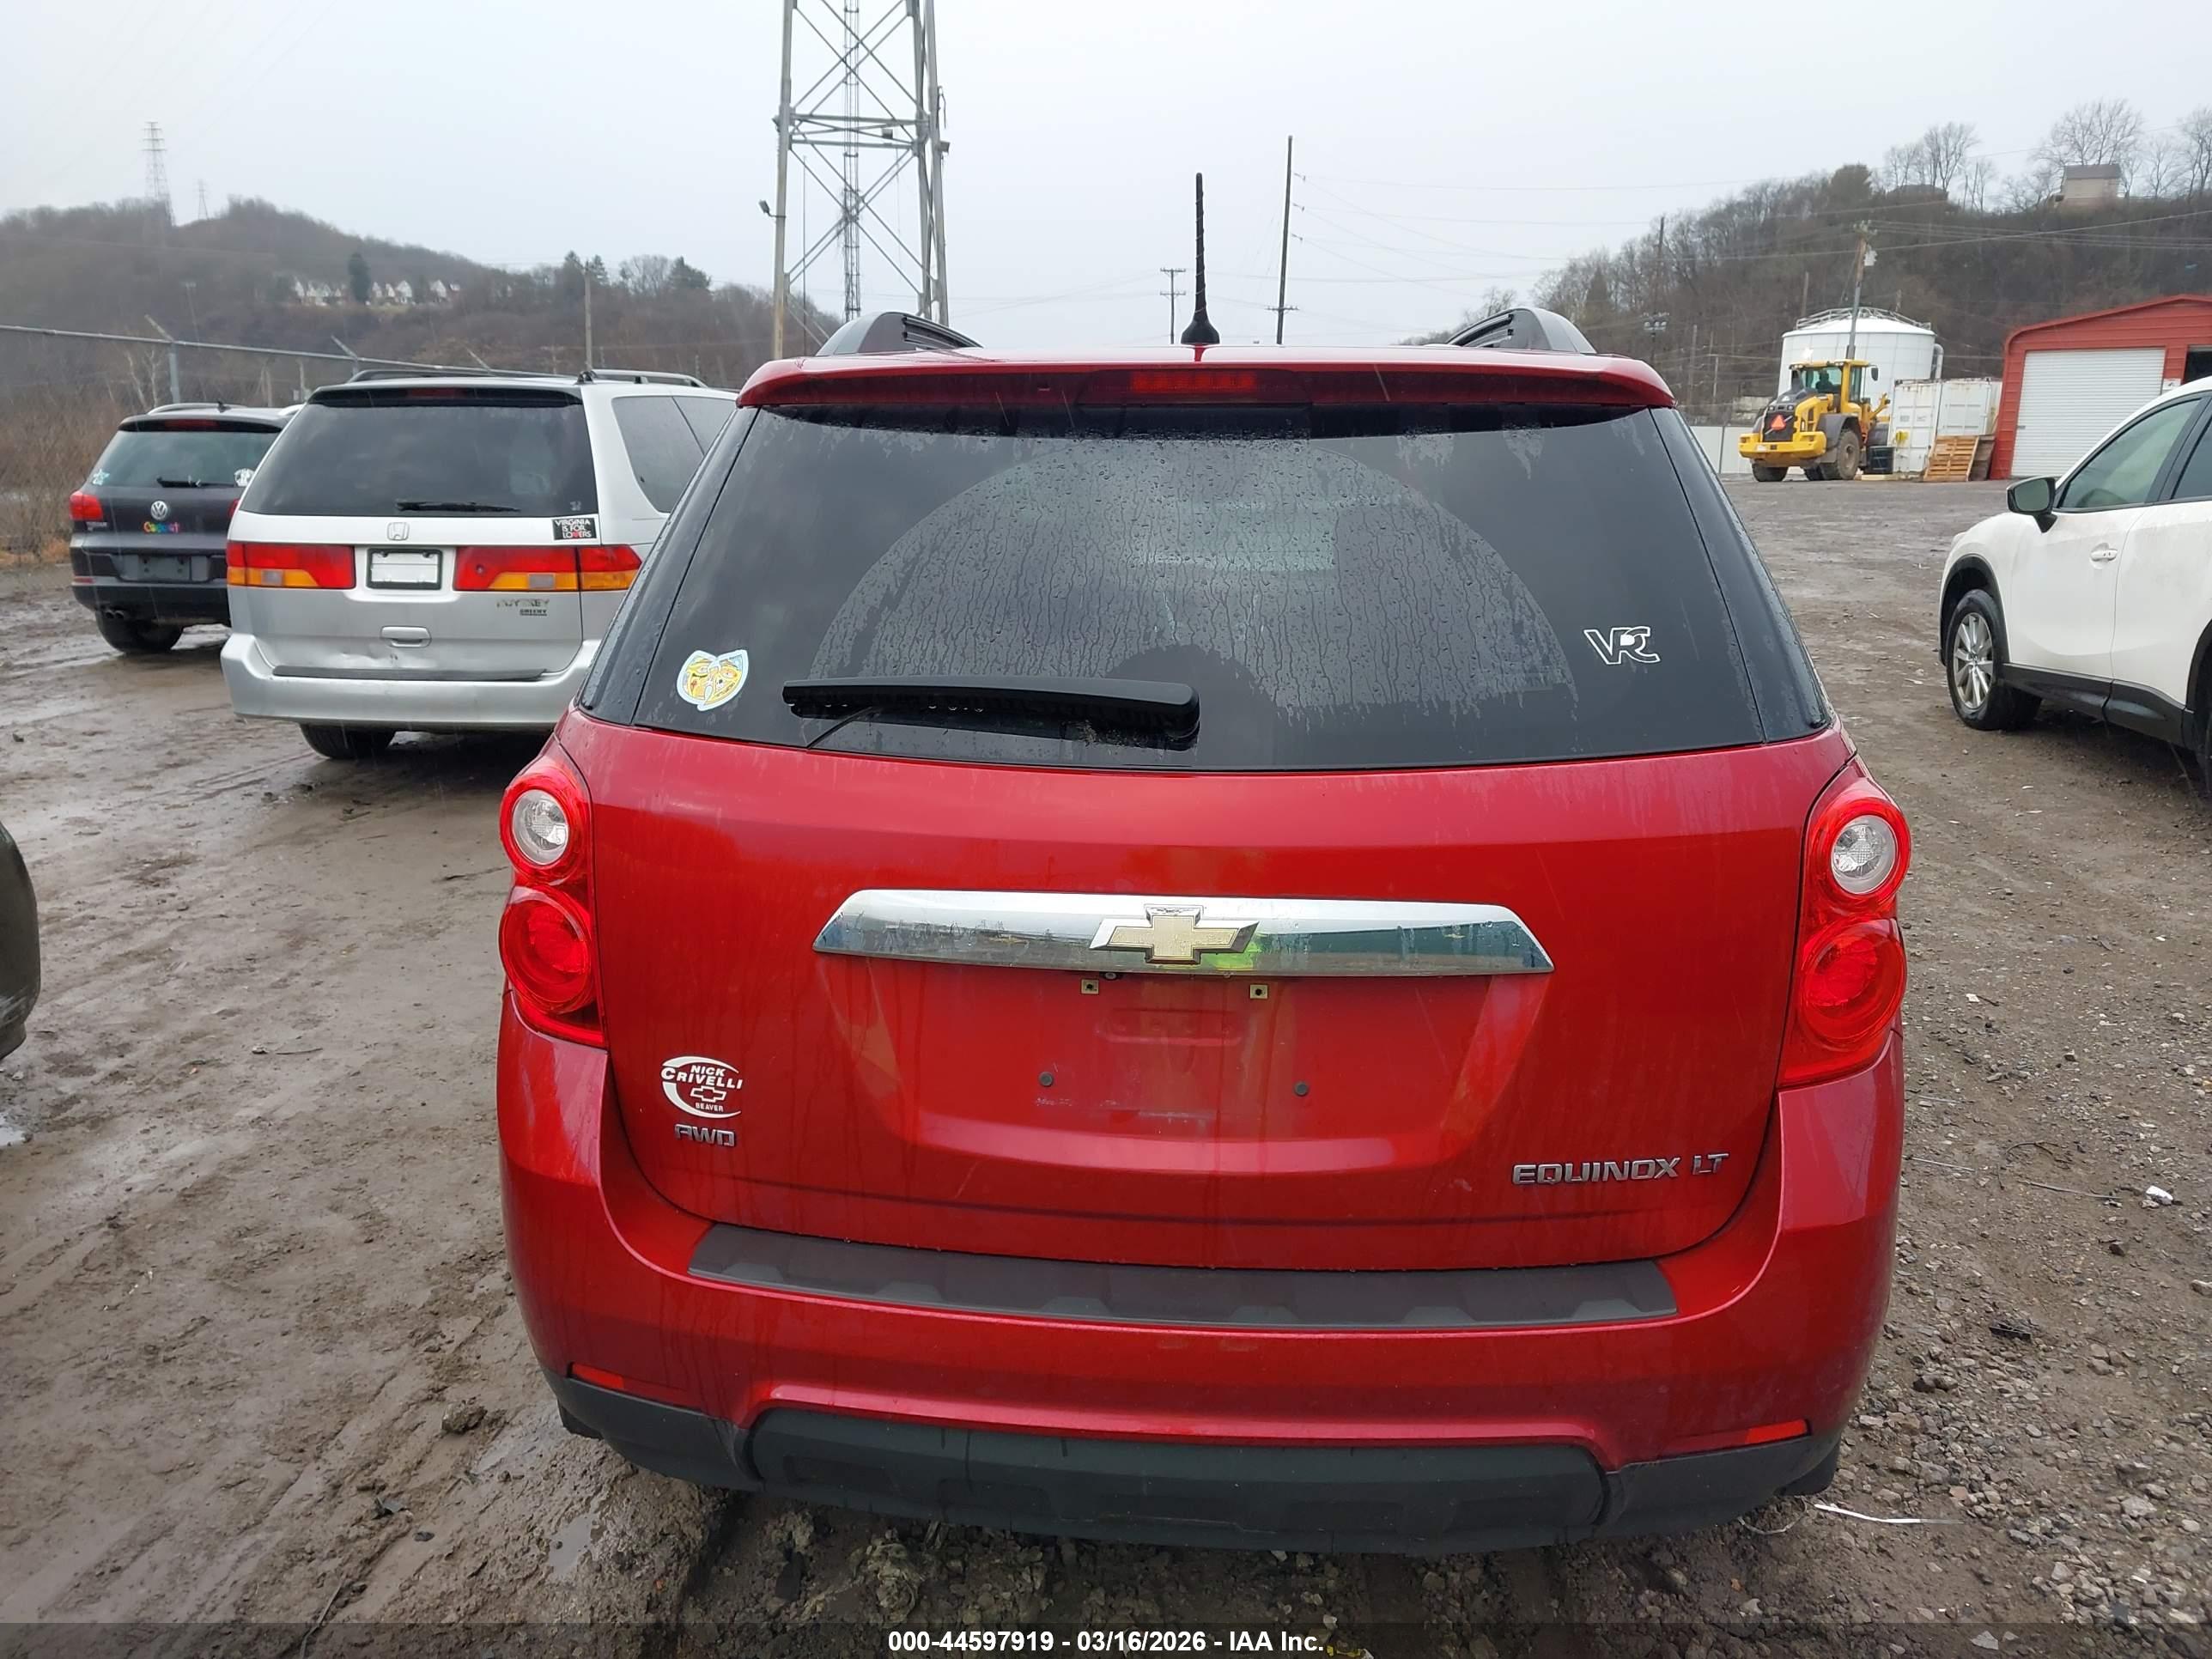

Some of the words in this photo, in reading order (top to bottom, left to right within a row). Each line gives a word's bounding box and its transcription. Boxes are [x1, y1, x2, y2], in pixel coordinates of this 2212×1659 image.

[562, 530, 592, 538] LOERS
[660, 1066, 744, 1090] CRIVELLI
[690, 1065, 726, 1077] NICK
[695, 1103, 724, 1113] BEAVER
[674, 1123, 736, 1147] AWD
[1512, 1157, 1681, 1185] EQUINOX
[1692, 1152, 1730, 1176] LT
